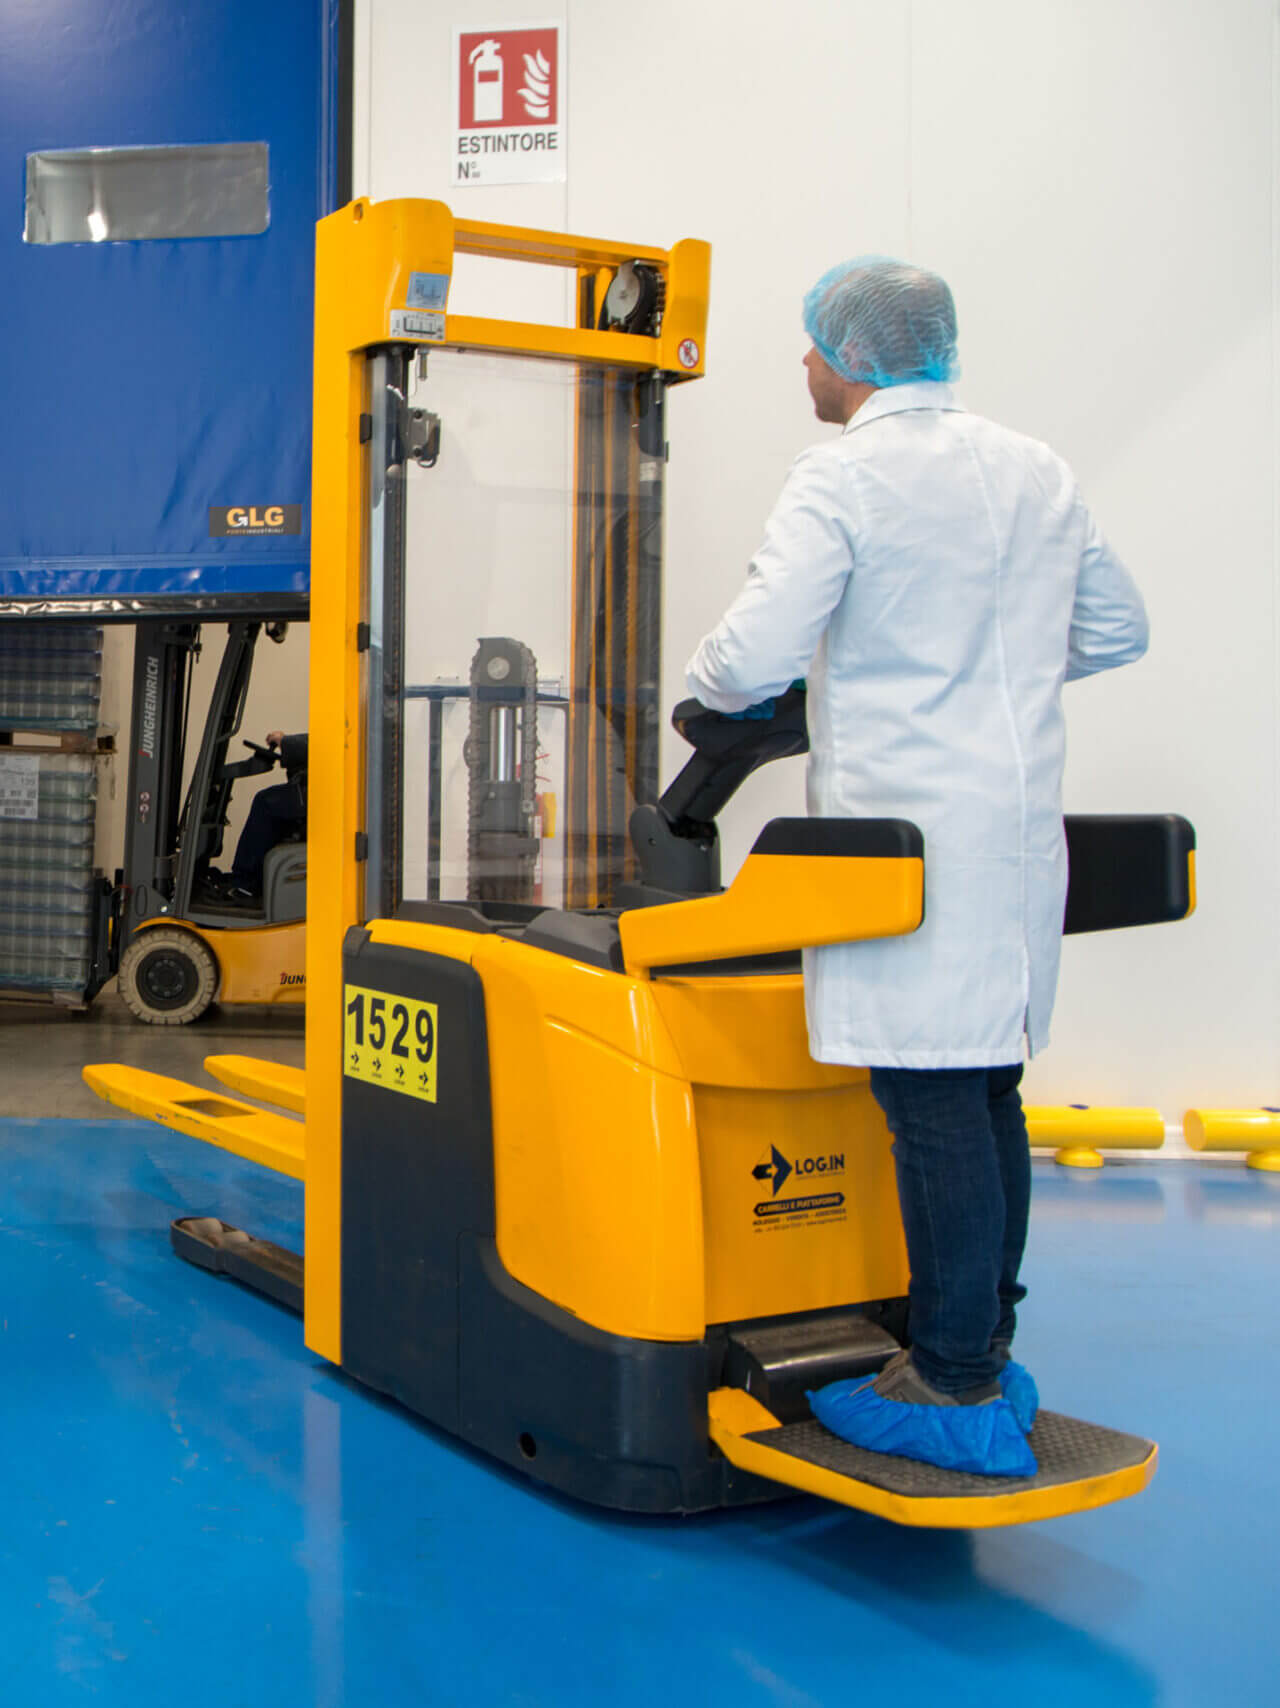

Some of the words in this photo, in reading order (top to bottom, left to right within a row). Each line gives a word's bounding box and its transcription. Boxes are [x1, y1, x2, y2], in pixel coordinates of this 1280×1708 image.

[458, 131, 558, 154] ESTINTORE
[226, 506, 284, 528] GLG
[138, 656, 159, 758] JUNGHEINRICH
[280, 972, 307, 985] JUN
[347, 993, 434, 1064] 1529
[795, 1153, 845, 1175] LOG.IN
